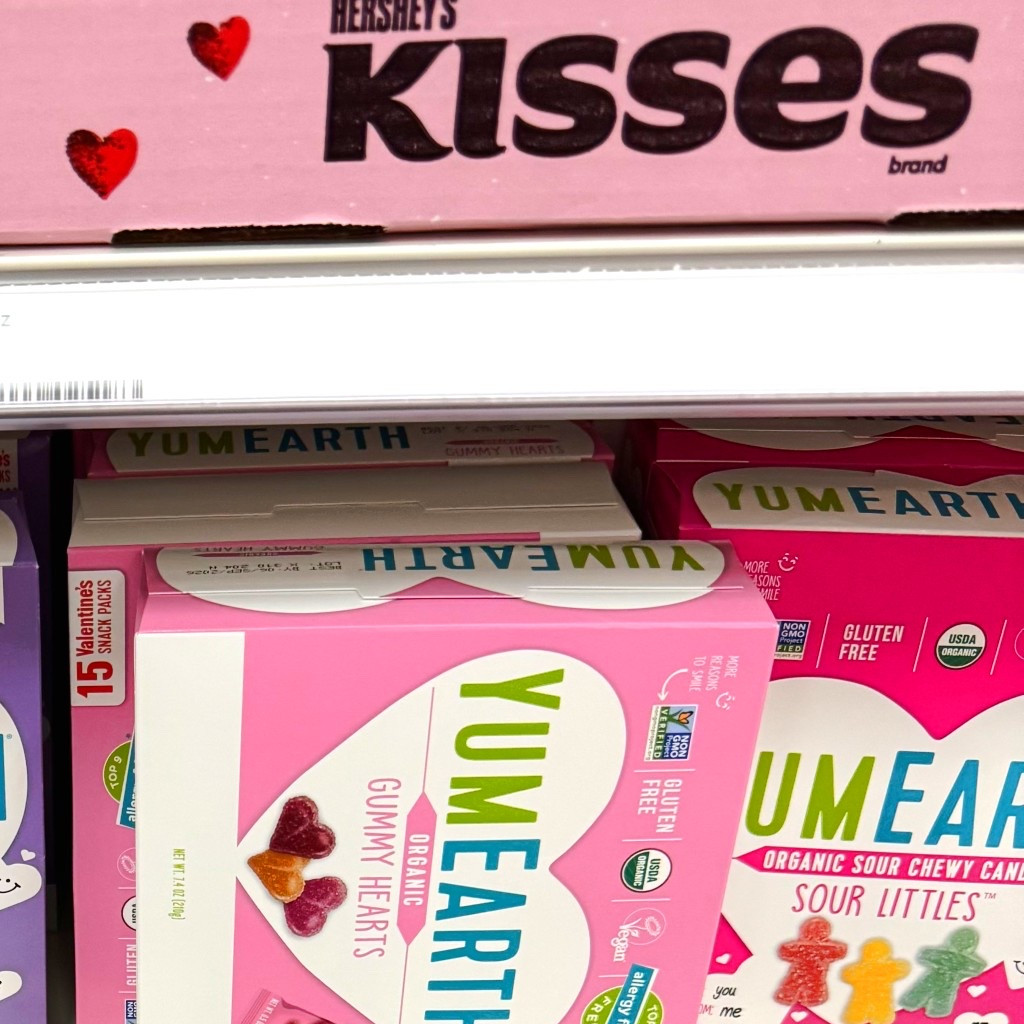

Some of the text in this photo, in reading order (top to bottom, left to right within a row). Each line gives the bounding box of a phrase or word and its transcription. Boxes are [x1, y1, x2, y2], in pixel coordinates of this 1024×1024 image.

[888, 155, 947, 176] brand
[128, 426, 411, 458] YUMEARTH
[75, 580, 94, 658] Valentine's
[97, 579, 112, 654] SNACK PACKS
[843, 624, 905, 643] GLUTEN
[838, 644, 880, 662] FREE
[941, 647, 978, 658] ORGANIC
[948, 634, 977, 646] USDA
[76, 660, 114, 699] 15
[637, 778, 659, 816] FREE
[655, 778, 684, 834] GLUTEN
[744, 750, 1024, 849] UMEAR
[353, 777, 402, 959] GUMMY HEARTS
[403, 833, 430, 907] ORGANIC
[646, 858, 661, 884] USDA
[763, 850, 844, 874] ORGANIC
[850, 854, 900, 876] SOUR
[907, 857, 974, 880] CHEWY
[791, 883, 981, 922] SOUR LITTLES
[618, 970, 644, 1018] allergy
